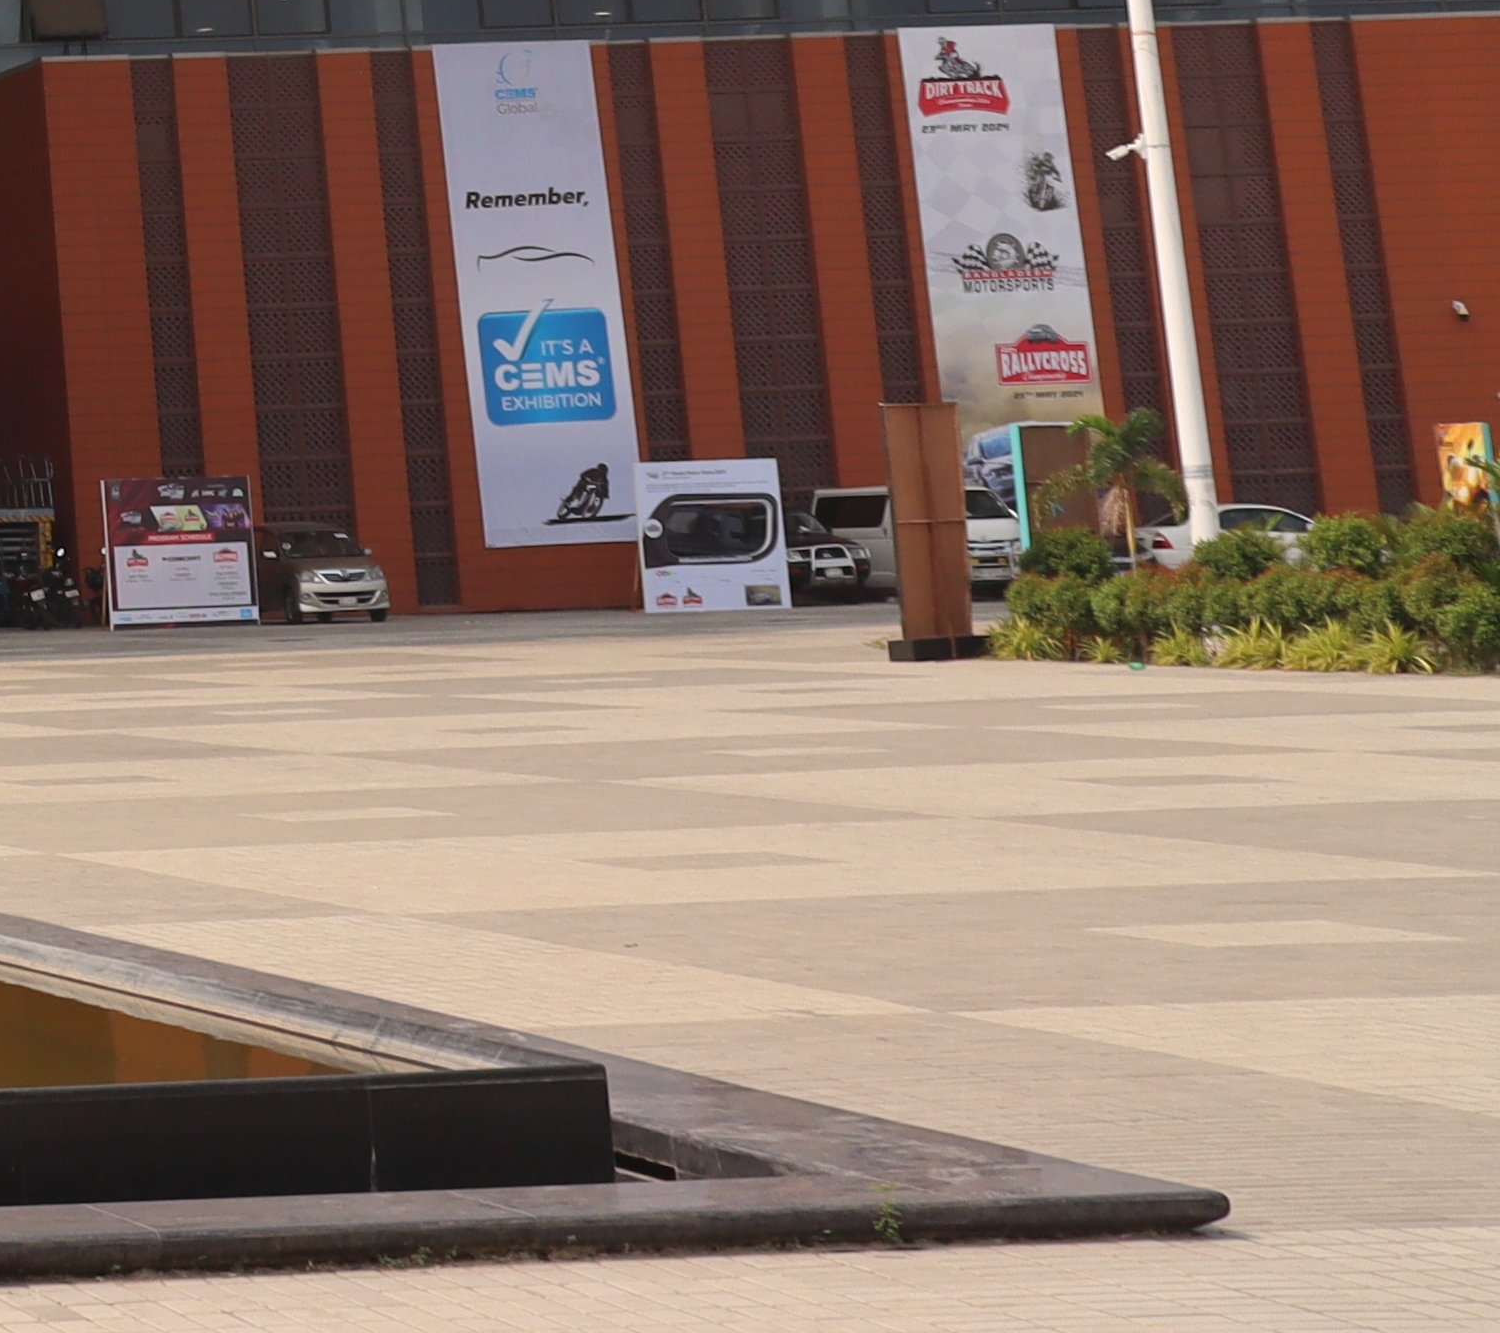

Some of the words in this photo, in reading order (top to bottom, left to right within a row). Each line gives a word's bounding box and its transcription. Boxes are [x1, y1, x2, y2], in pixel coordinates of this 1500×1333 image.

[924, 82, 956, 100] DIRT
[956, 80, 1003, 98] TRACK
[496, 103, 538, 114] Global
[465, 187, 589, 209] Remember,
[963, 279, 1054, 293] MOTORSPORTS
[541, 339, 574, 356] IT'S
[579, 338, 594, 354] A
[1001, 351, 1089, 378] RALLYCROSS
[501, 392, 602, 411] EXHIBITION
